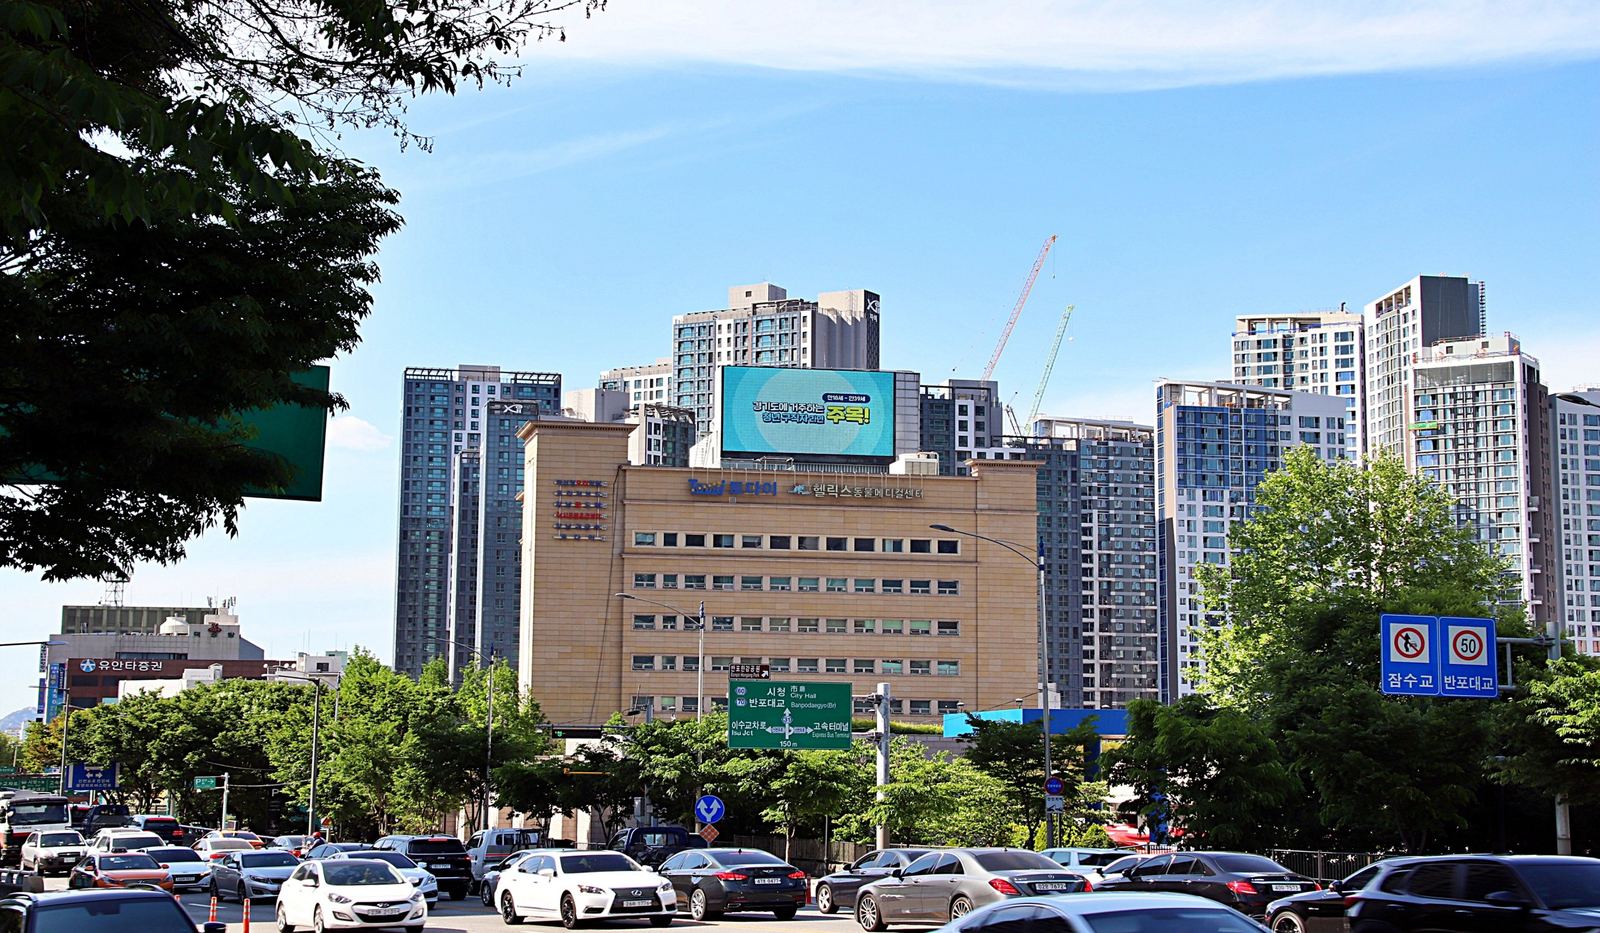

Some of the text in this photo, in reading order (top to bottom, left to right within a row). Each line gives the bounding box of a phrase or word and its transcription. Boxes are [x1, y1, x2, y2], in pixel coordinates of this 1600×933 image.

[753, 401, 825, 414] 경기도에 거주하는
[762, 412, 781, 423] 청년
[826, 405, 871, 425] 주목!
[1461, 638, 1476, 653] 50
[98, 660, 163, 672] 유안타증권
[1388, 673, 1434, 688] 잠수교
[1444, 675, 1494, 691] 반포대교
[766, 687, 786, 697] 시청
[749, 698, 785, 708] 반포대교
[731, 720, 766, 730] 이수교차로
[813, 721, 849, 731] 고속터미널
[271, 788, 279, 797] P
